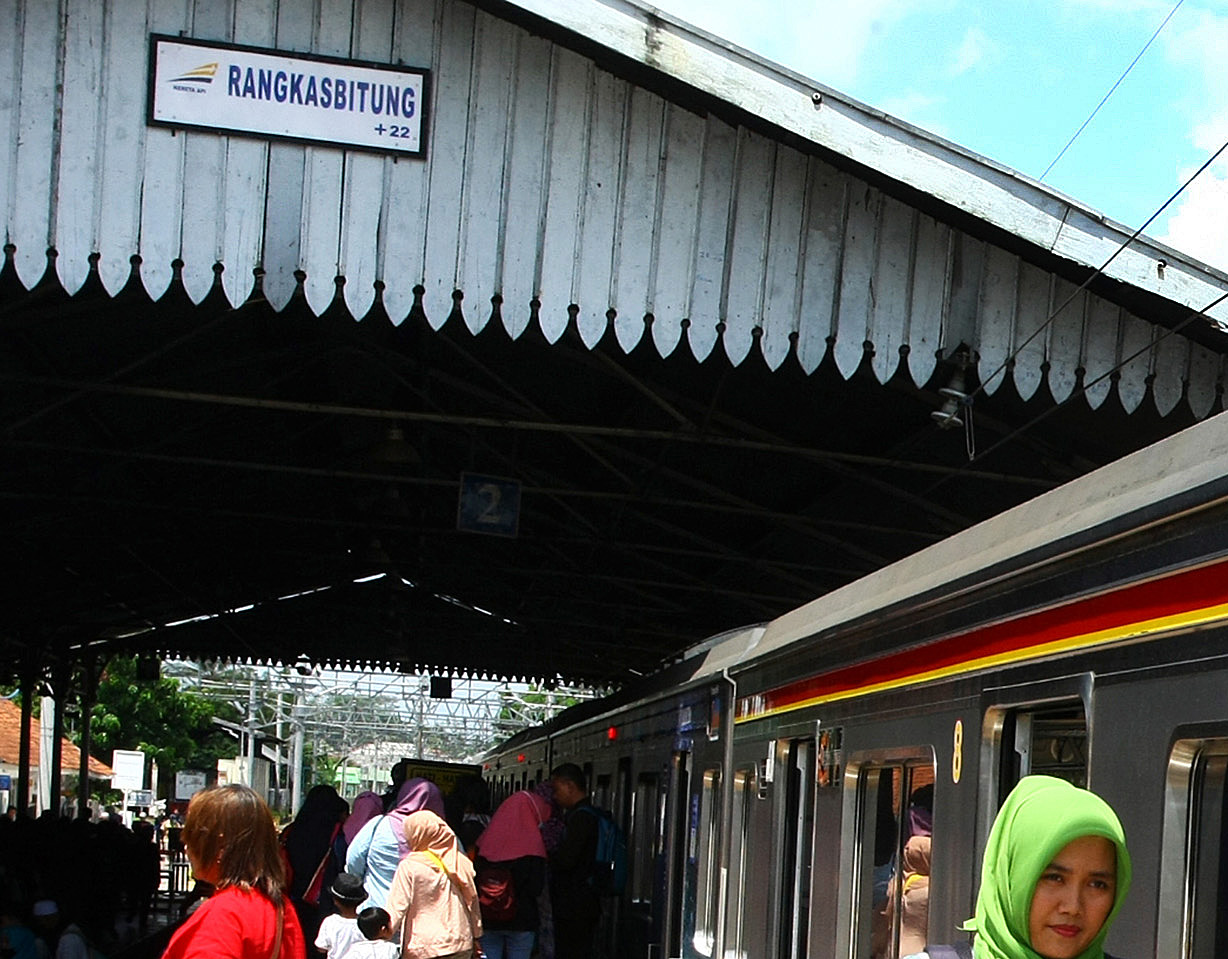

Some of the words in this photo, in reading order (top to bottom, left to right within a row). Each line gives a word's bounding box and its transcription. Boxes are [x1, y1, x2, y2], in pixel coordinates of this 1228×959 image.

[228, 65, 415, 119] RANGKASBITUNG
[374, 123, 410, 139] +22
[477, 483, 501, 524] 2
[952, 720, 963, 784] 8
